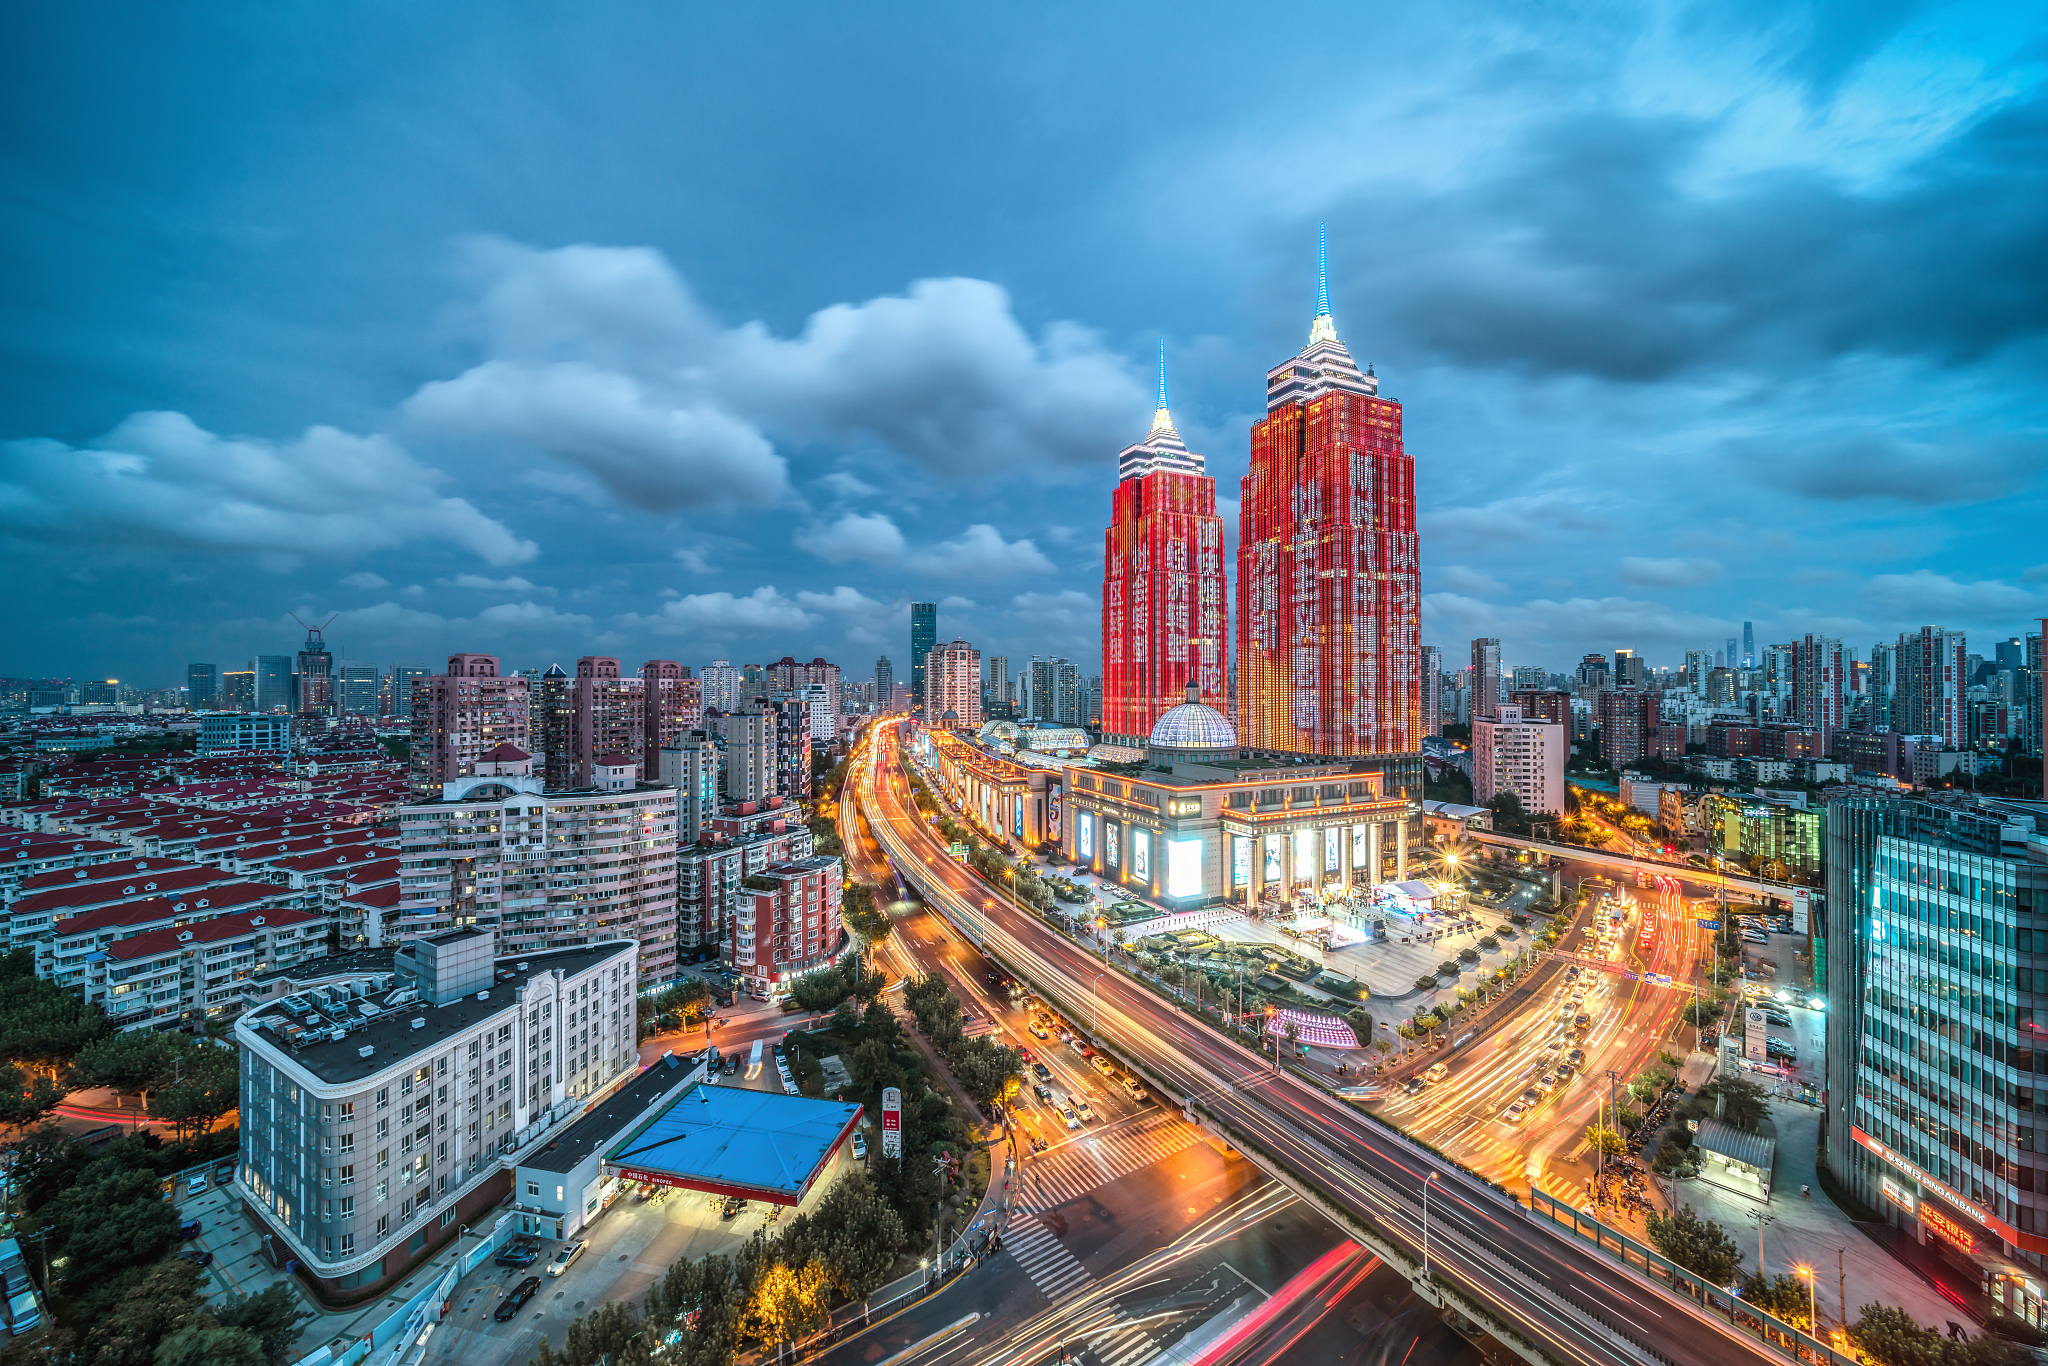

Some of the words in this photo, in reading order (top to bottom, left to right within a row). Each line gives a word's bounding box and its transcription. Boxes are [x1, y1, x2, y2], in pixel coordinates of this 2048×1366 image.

[628, 1172, 648, 1181] 中国石化
[1886, 1151, 1921, 1180] 平安银行
[1959, 1200, 1985, 1223] BANK
[1920, 1202, 1973, 1246] 平安银行
[1950, 1233, 1971, 1254] BANK
